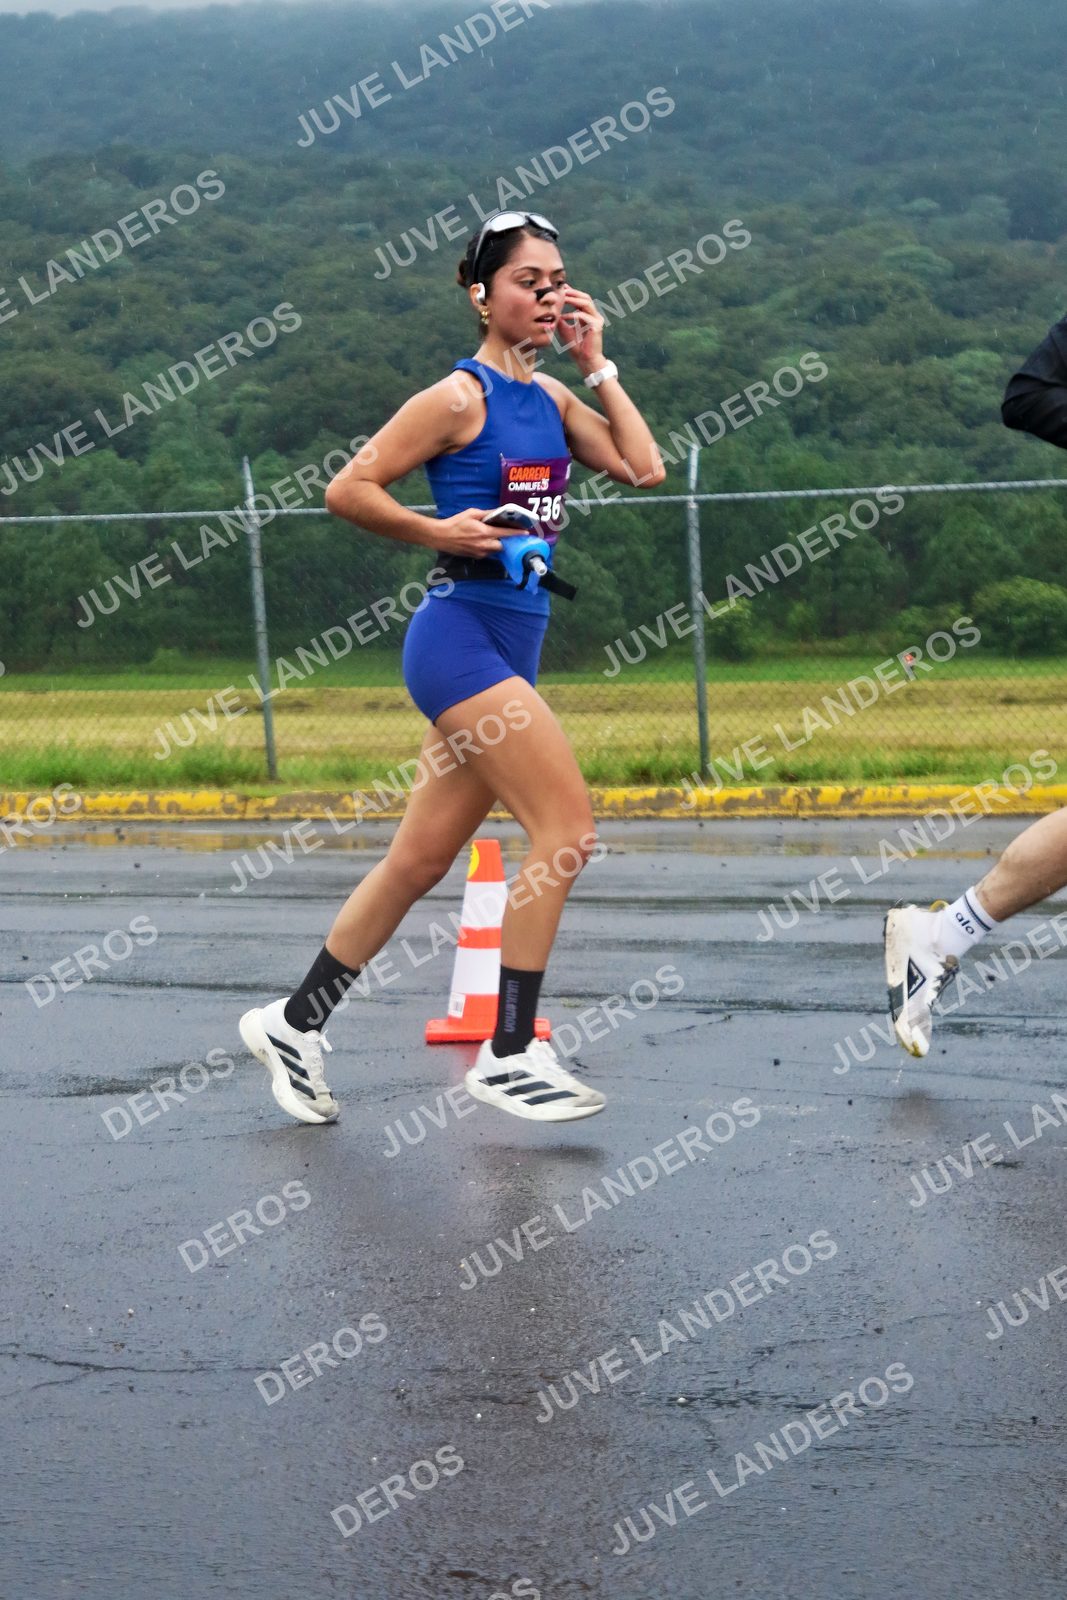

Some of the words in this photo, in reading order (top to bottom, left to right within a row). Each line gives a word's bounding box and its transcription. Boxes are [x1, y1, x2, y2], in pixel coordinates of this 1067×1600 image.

[508, 466, 551, 481] CARRERA
[528, 495, 562, 521] 736
[955, 912, 975, 935] alo
